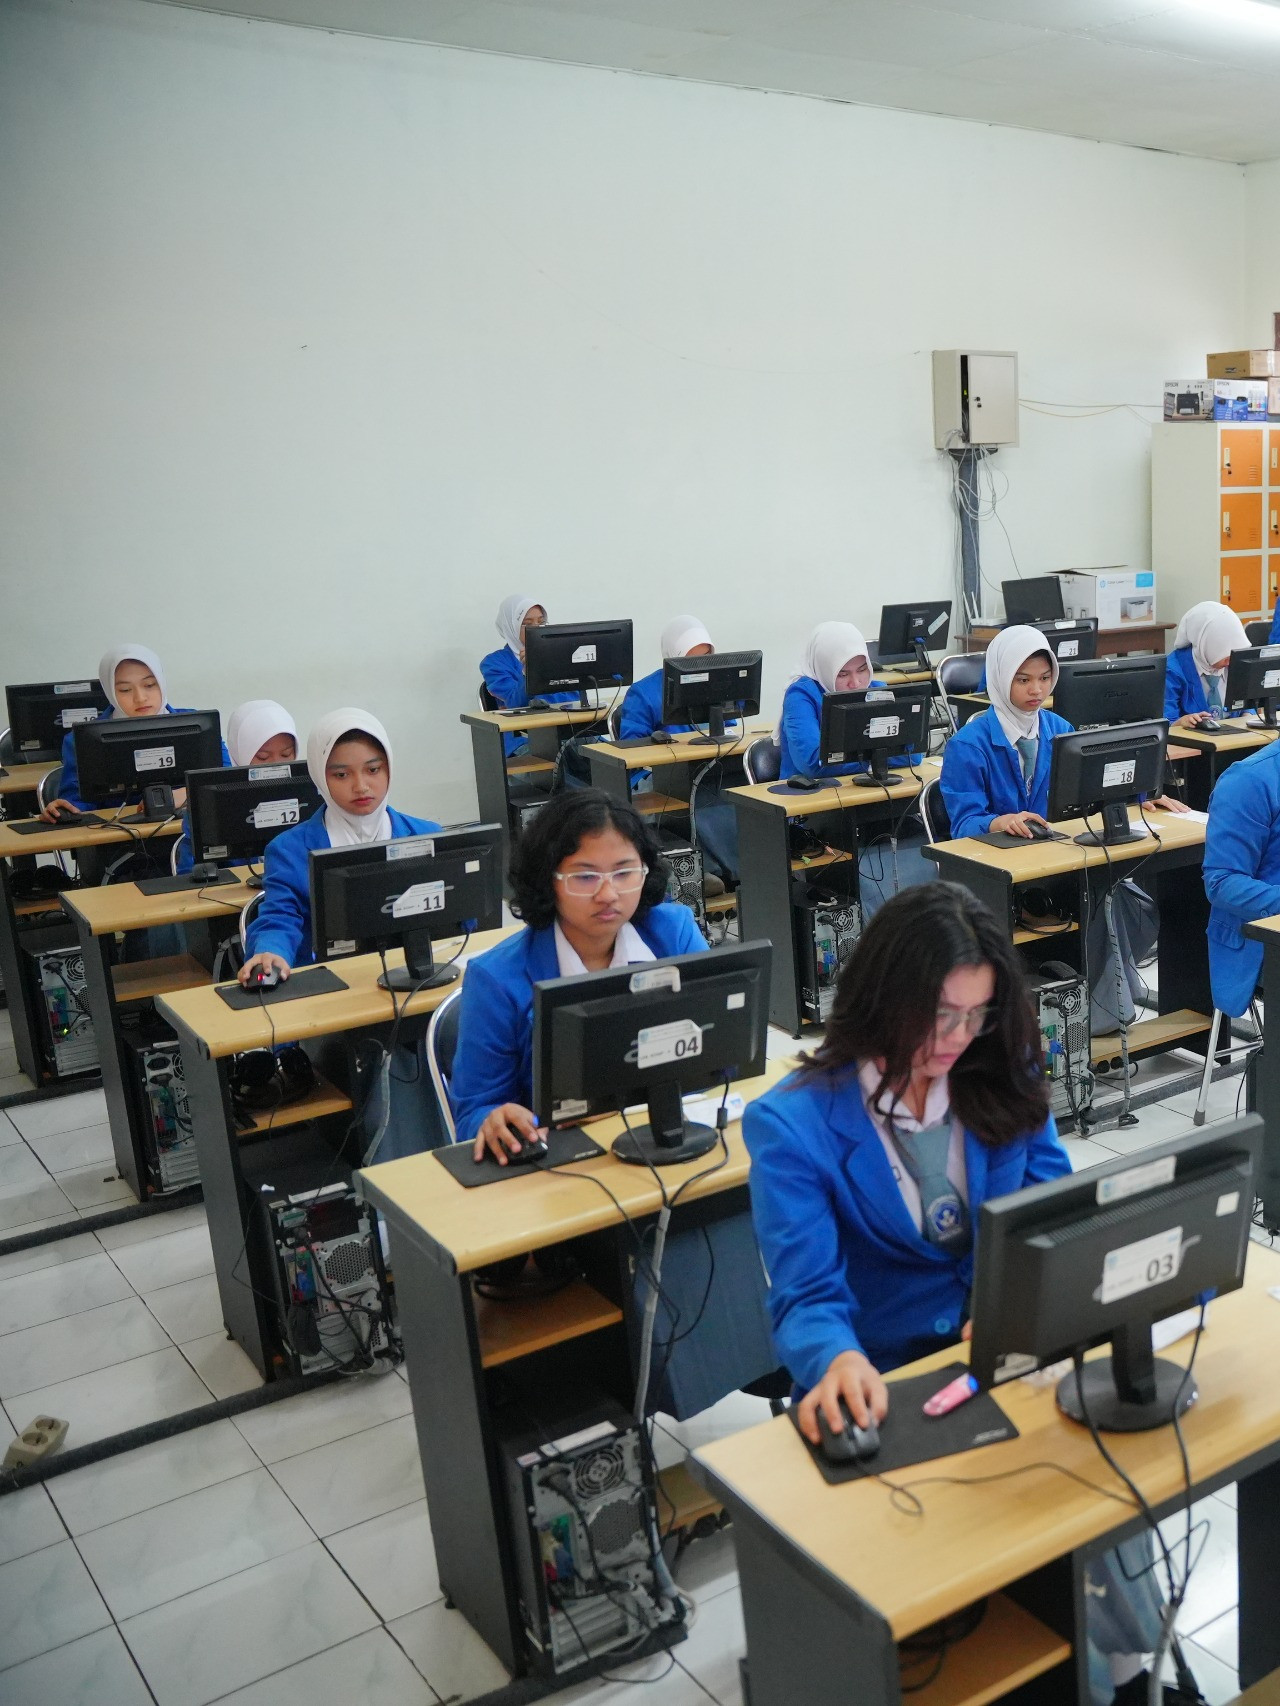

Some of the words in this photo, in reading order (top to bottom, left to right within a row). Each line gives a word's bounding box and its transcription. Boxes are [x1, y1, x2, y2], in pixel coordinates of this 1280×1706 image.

[585, 653, 595, 661] 11
[1069, 647, 1076, 656] 21
[886, 725, 897, 736] 13
[158, 756, 174, 767] 19
[1120, 771, 1133, 783] 18
[280, 811, 298, 824] 12
[423, 895, 442, 911] 11
[674, 1036, 699, 1057] 04
[1146, 1254, 1173, 1282] 03
